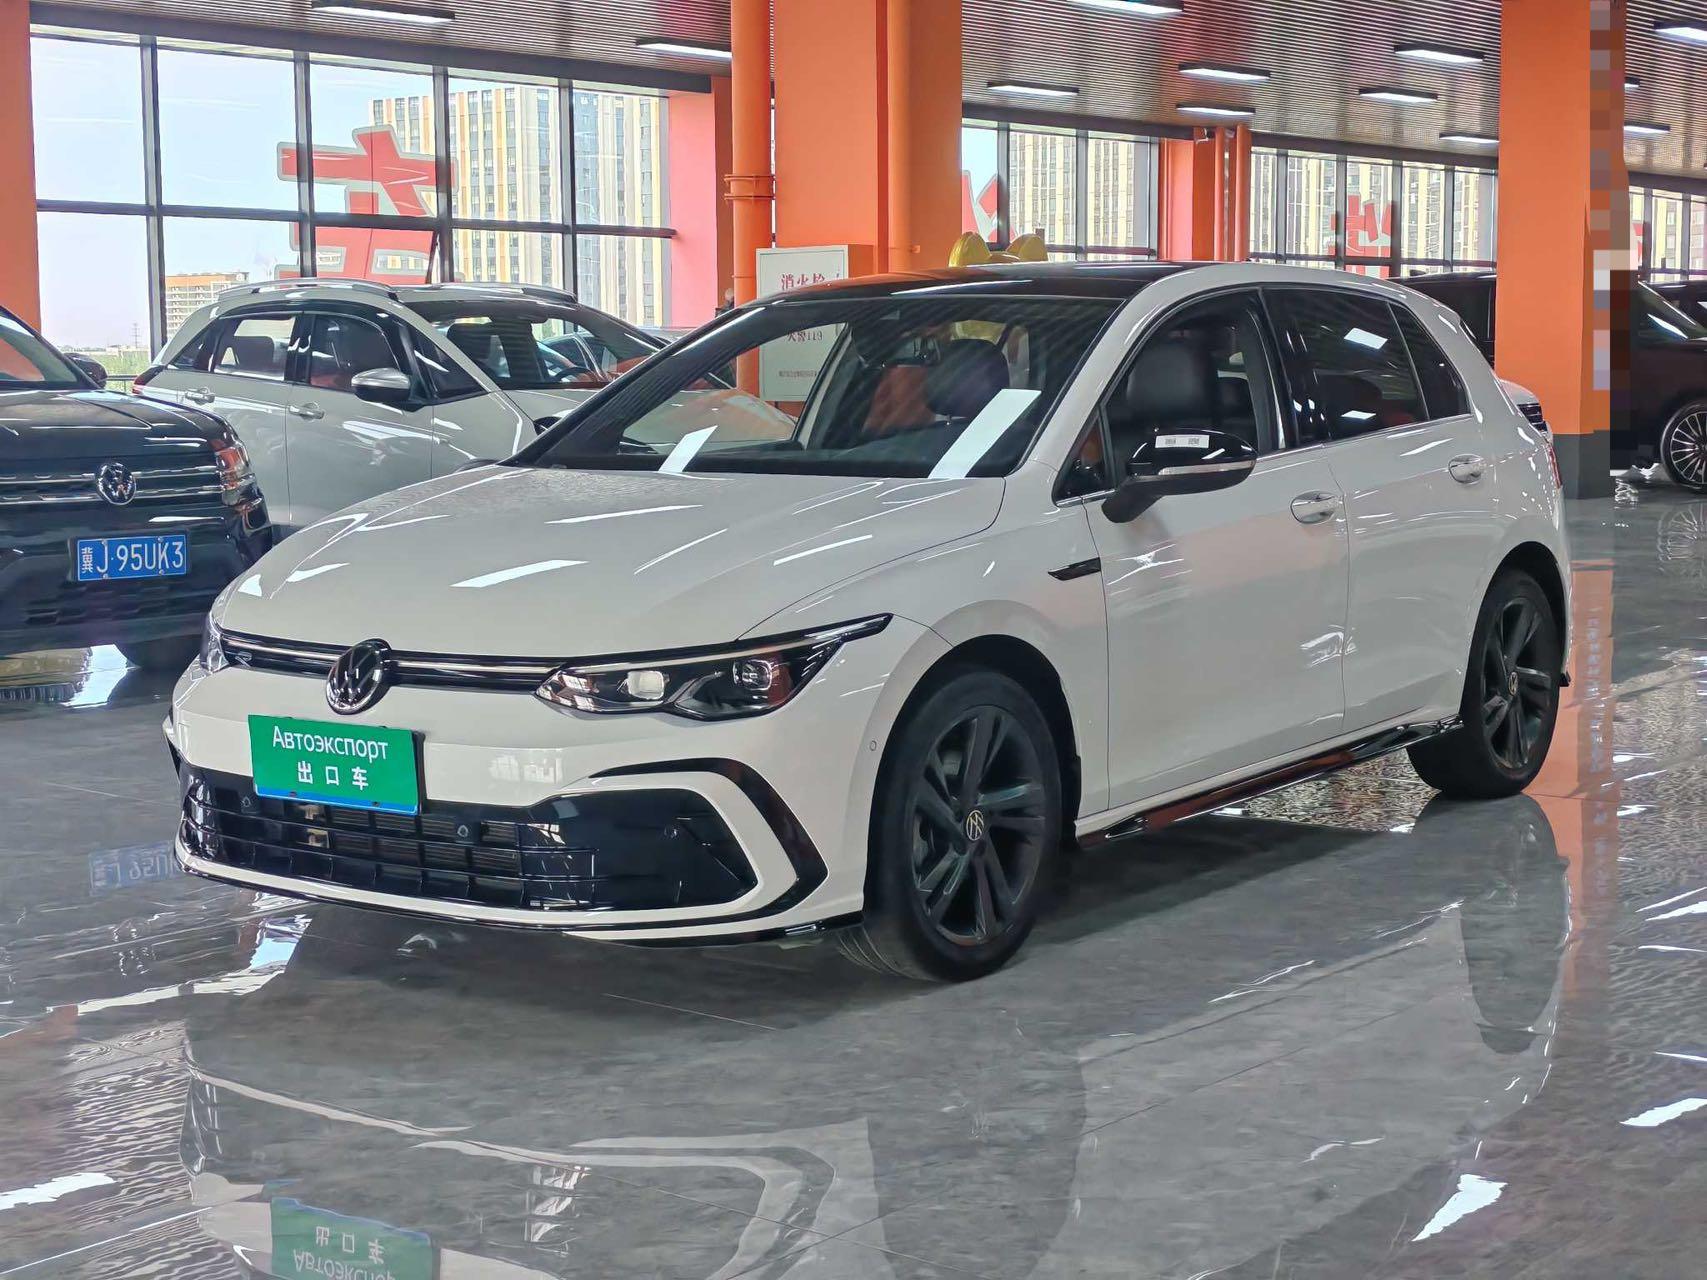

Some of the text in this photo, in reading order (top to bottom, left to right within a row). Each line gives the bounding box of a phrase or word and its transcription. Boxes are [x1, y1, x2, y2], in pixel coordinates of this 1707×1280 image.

[272, 725, 388, 764] Автоэкспорт
[297, 760, 369, 791] 出口车
